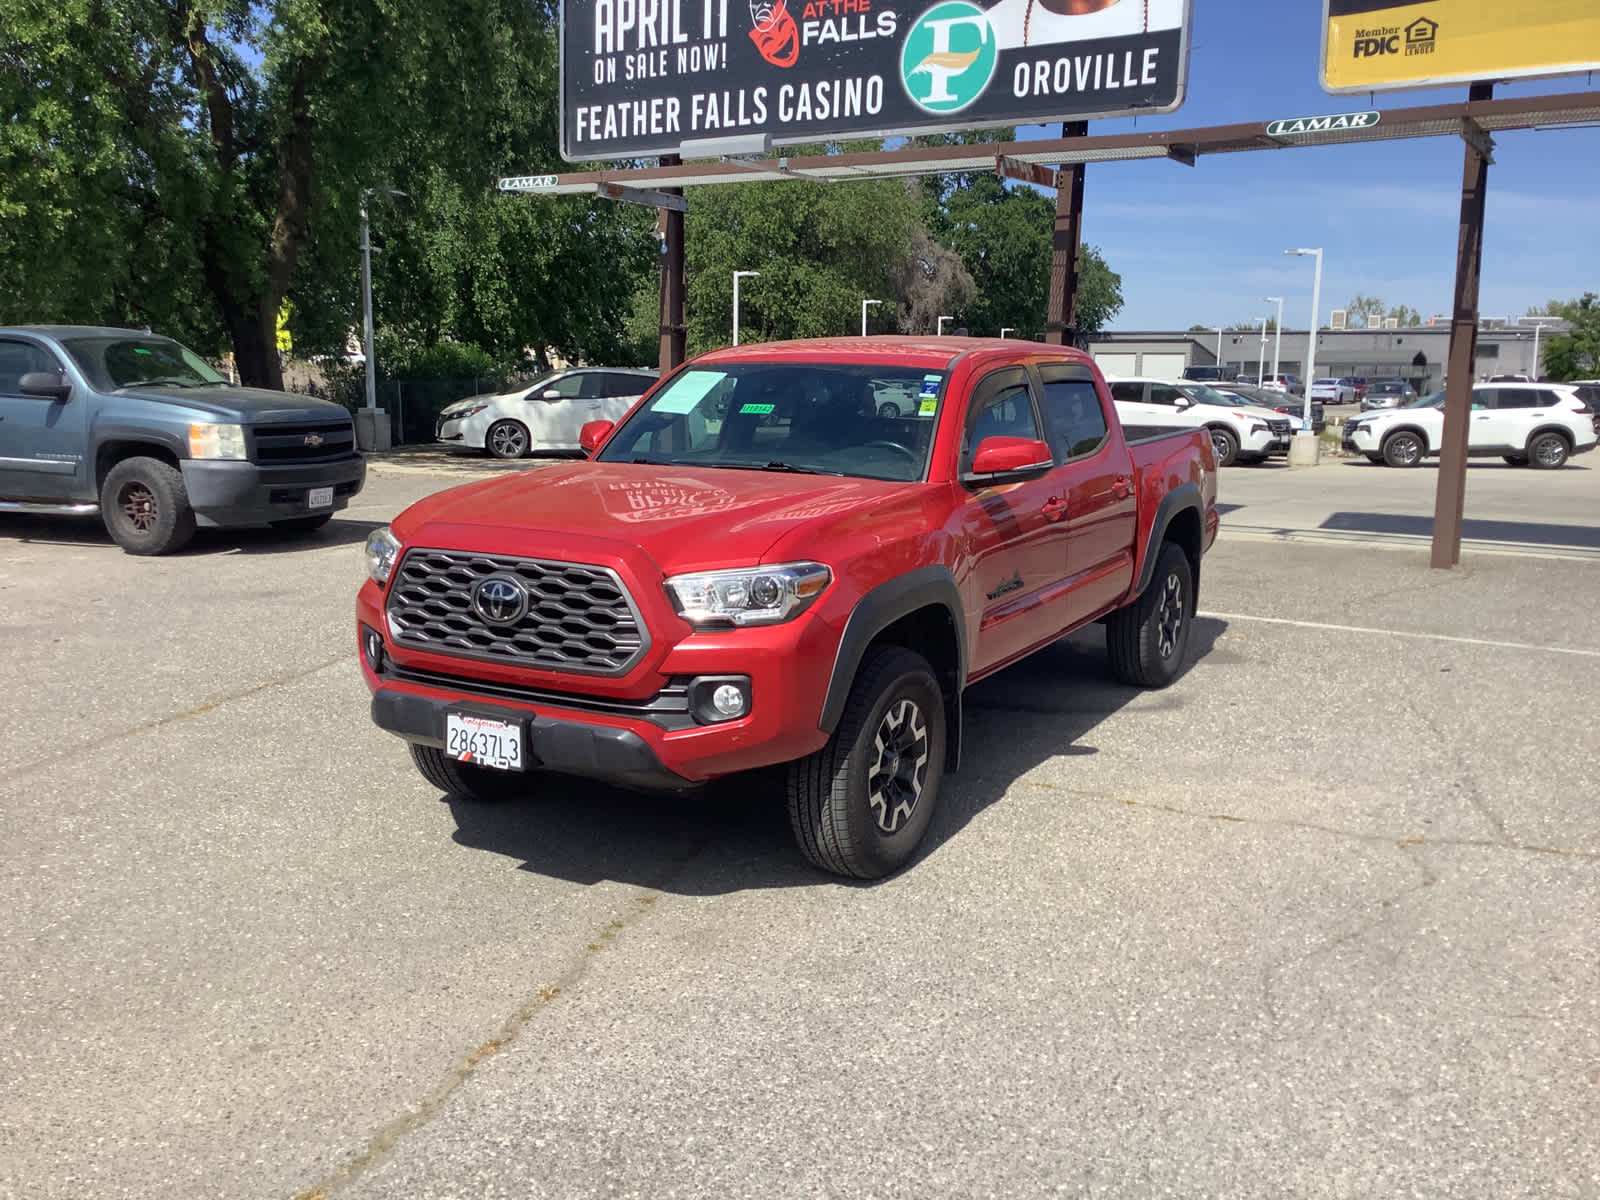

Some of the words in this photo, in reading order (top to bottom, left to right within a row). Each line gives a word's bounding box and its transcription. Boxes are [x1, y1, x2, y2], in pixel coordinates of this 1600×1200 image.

[802, 0, 828, 19] AT
[830, 0, 871, 15] THE
[595, 0, 689, 54] APRIL
[802, 10, 897, 46] FALLS
[1355, 26, 1400, 38] Member
[594, 57, 616, 84] ON
[625, 50, 668, 80] SALE
[677, 42, 727, 74] NOW!
[1353, 35, 1400, 58] FDIC
[1013, 48, 1159, 97] OROVILLE
[576, 97, 680, 142] FEATHER
[691, 87, 768, 130] FALLS
[778, 75, 884, 122] CASINO
[1275, 114, 1369, 134] LAMAR
[504, 176, 553, 188] LAMAR
[450, 728, 519, 761] 28637L3
